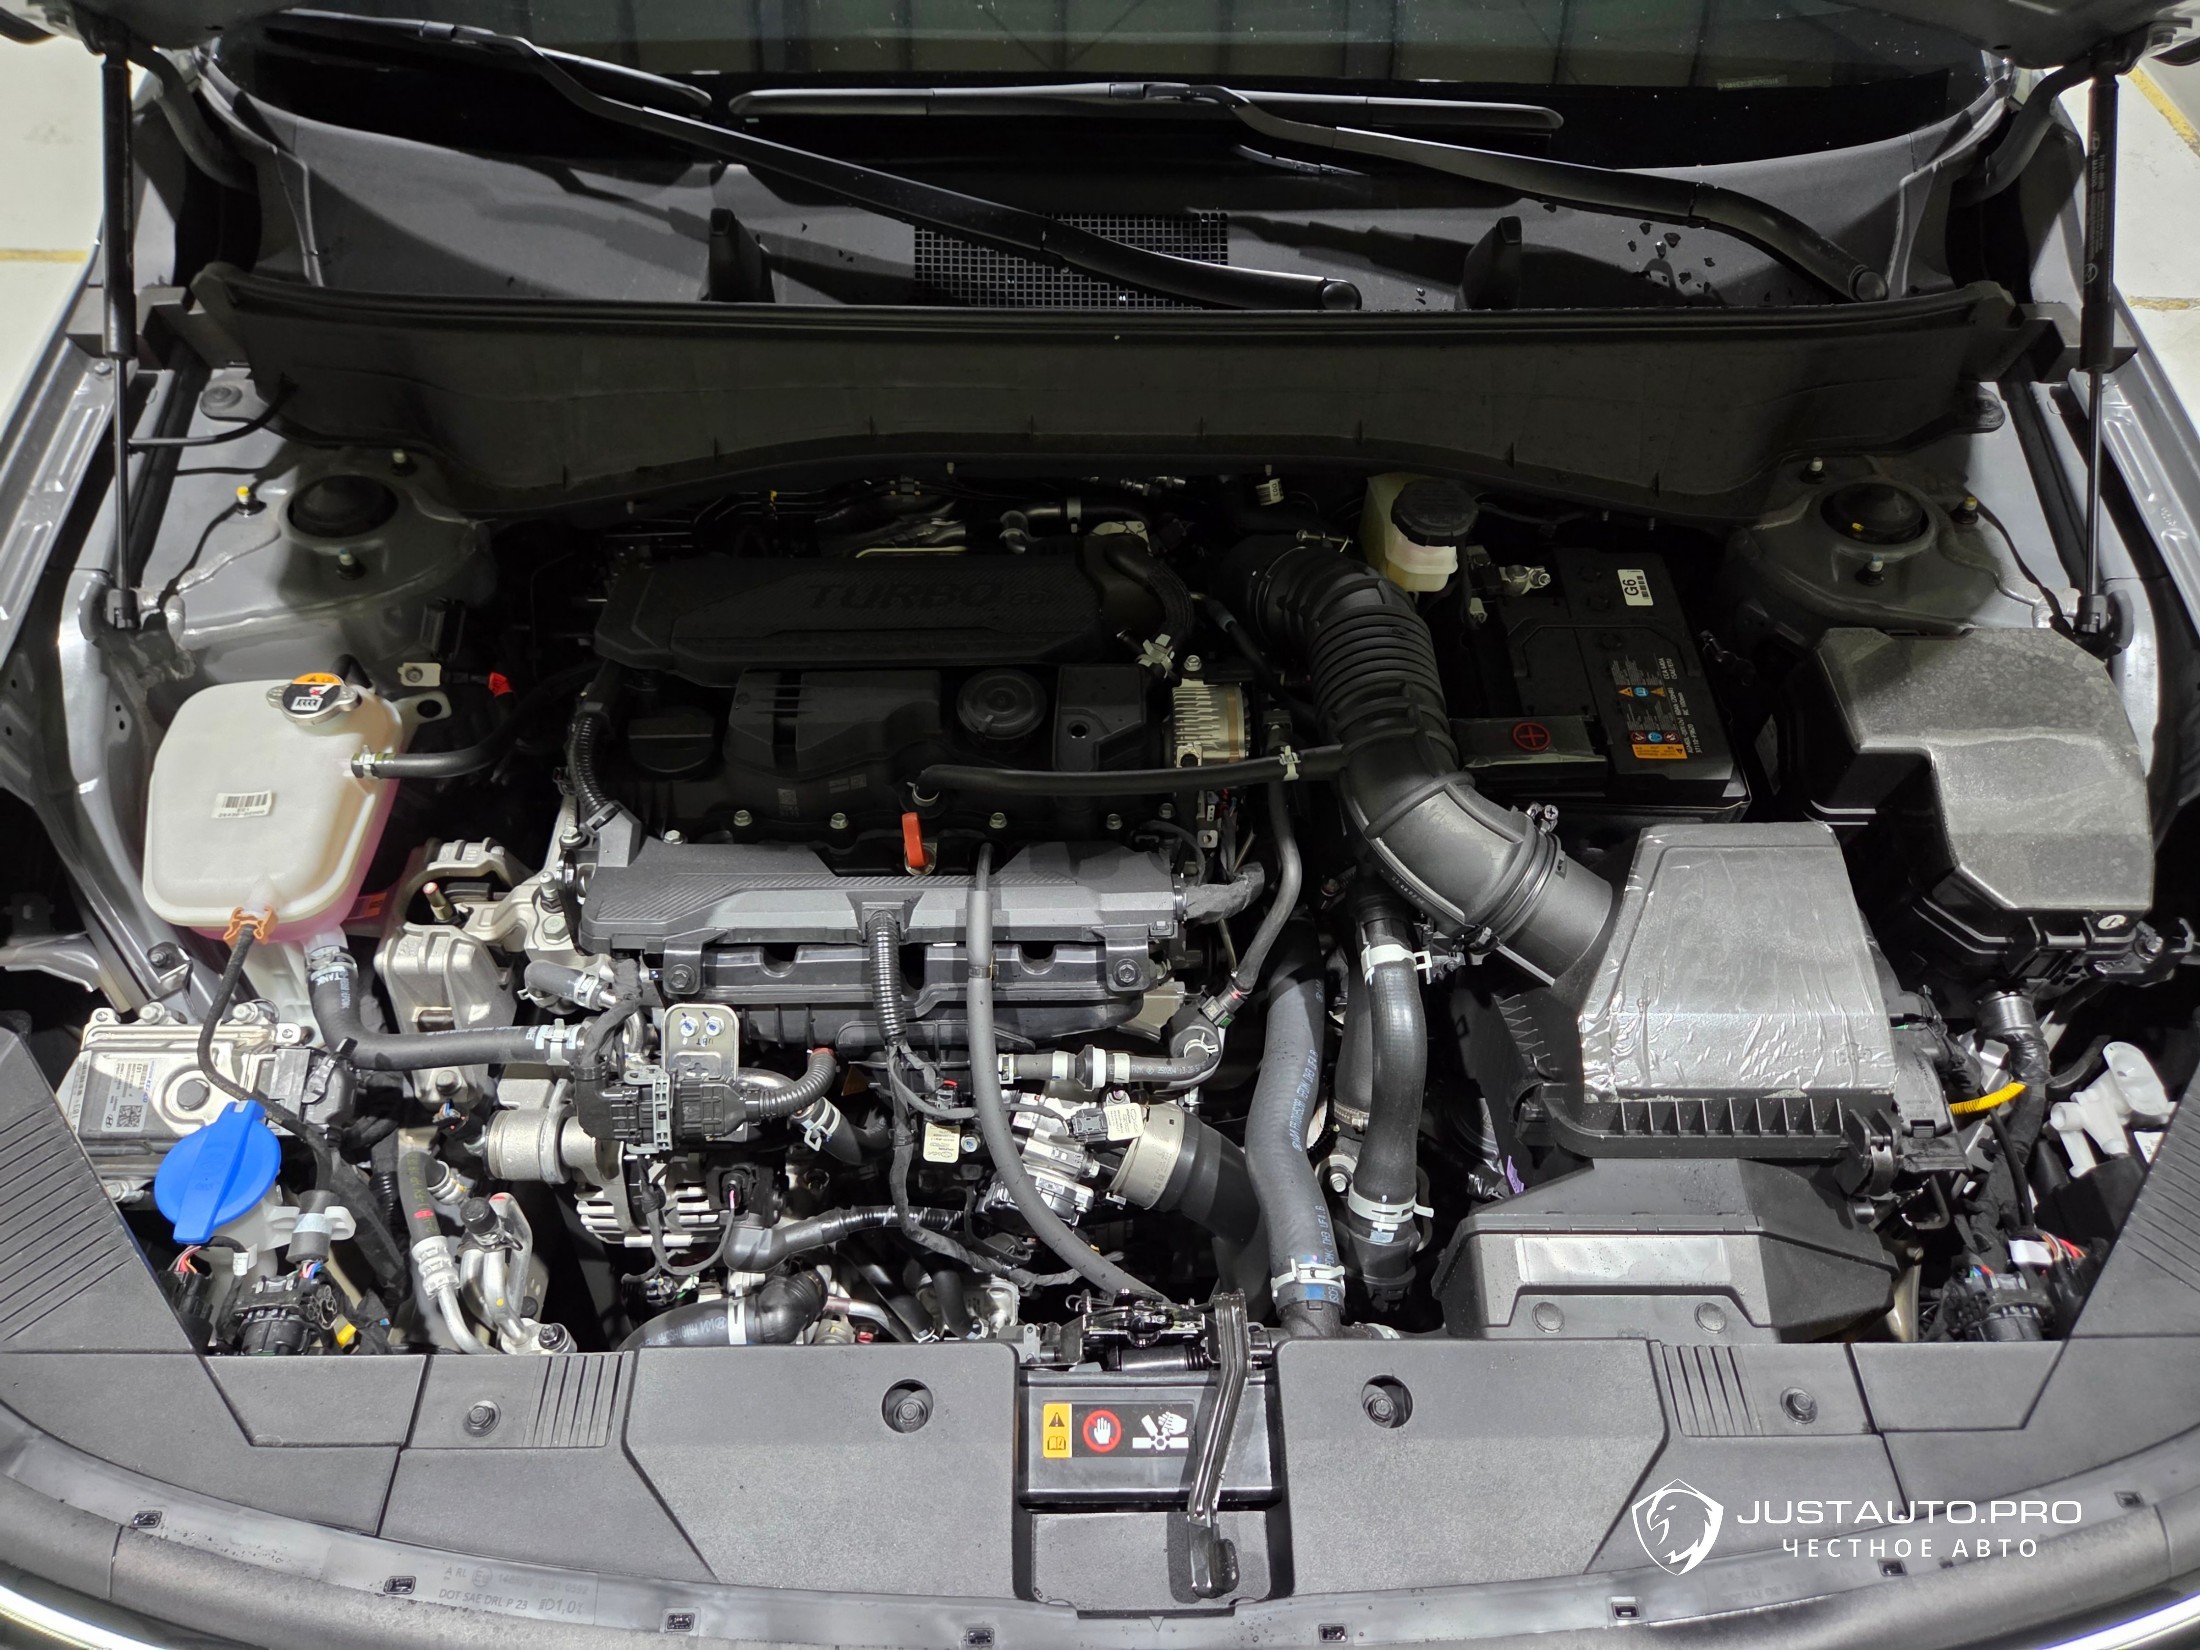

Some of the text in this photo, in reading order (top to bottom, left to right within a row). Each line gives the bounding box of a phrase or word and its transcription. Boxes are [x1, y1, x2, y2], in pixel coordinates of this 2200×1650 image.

[806, 582, 1002, 609] TURBO
[1622, 578, 1639, 596] G6
[1662, 669, 1670, 680] CCA
[317, 971, 342, 985] TANK
[438, 1588, 460, 1600] DOT
[462, 1592, 483, 1604] SAE
[484, 1594, 503, 1607] DRL
[505, 1599, 513, 1608] P
[514, 1599, 529, 1610] 23
